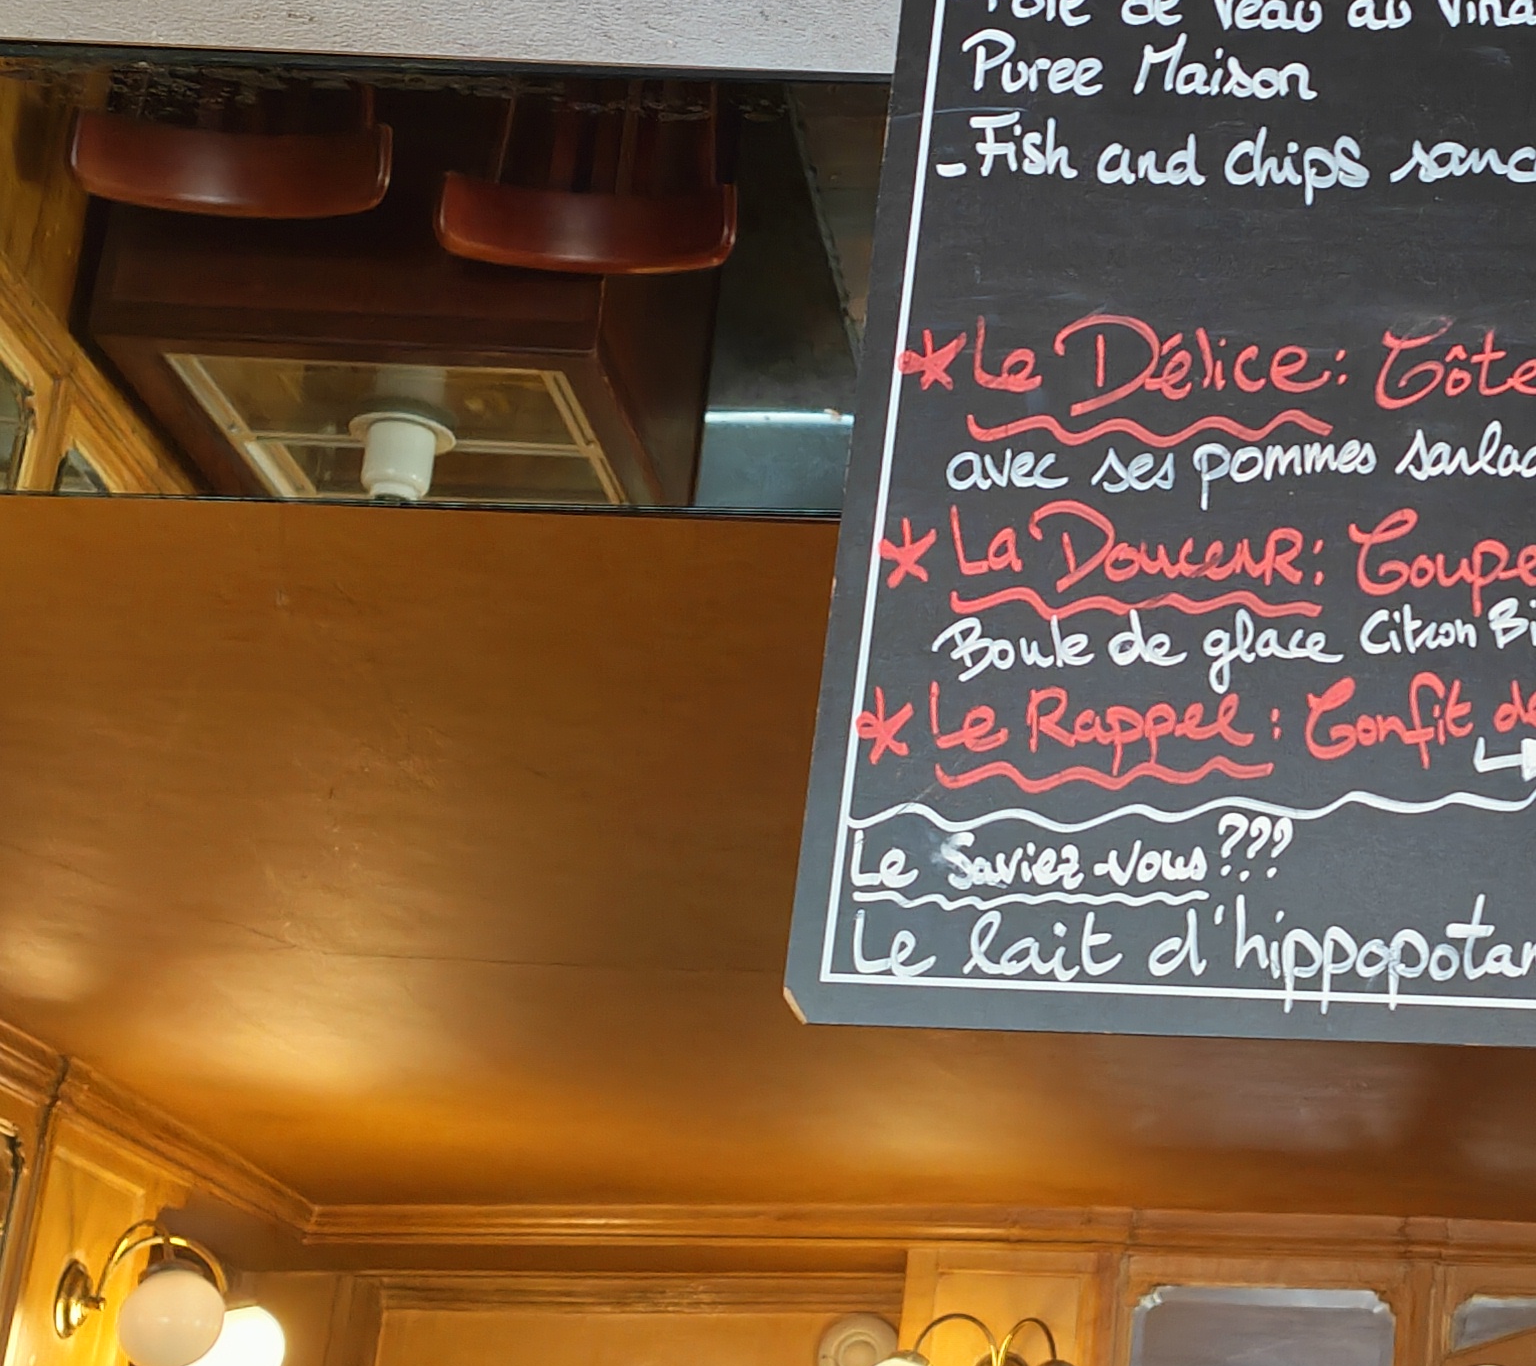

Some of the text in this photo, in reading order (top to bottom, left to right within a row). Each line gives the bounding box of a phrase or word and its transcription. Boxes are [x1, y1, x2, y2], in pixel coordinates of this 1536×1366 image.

[1133, 32, 1318, 101] Maison
[1096, 131, 1207, 188] and
[944, 446, 1070, 492] avec
[1090, 446, 1176, 493] ses
[1191, 438, 1378, 512] pommes
[949, 503, 1024, 577] La
[930, 613, 1096, 683] Boule
[1106, 608, 1189, 667] de
[1200, 606, 1345, 695] glace
[850, 828, 920, 888] Le
[852, 908, 938, 979] Le
[962, 909, 1124, 983] lait
